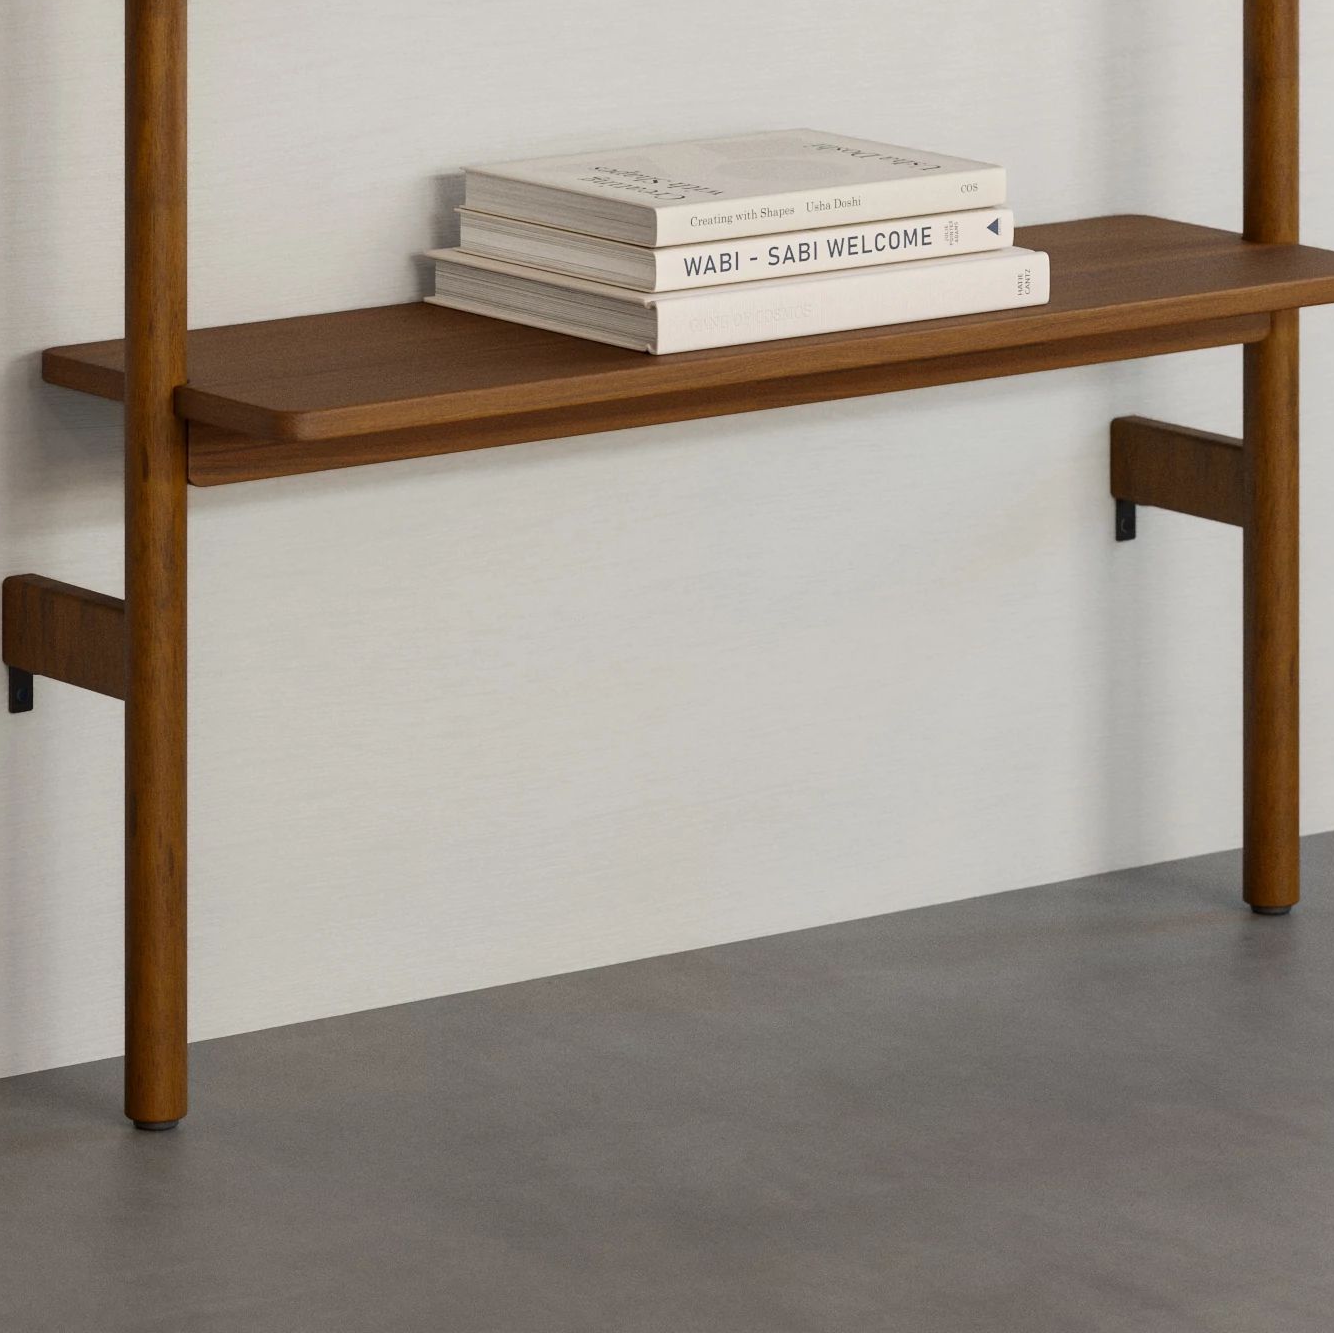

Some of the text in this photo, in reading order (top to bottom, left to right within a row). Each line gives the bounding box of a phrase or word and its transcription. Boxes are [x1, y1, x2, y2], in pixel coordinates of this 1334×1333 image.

[960, 182, 979, 194] COS
[690, 196, 862, 228] Creating with Shapes Usha Doshi
[683, 251, 740, 277] WABI
[767, 241, 819, 266] SABI
[826, 226, 933, 259] WELCOME
